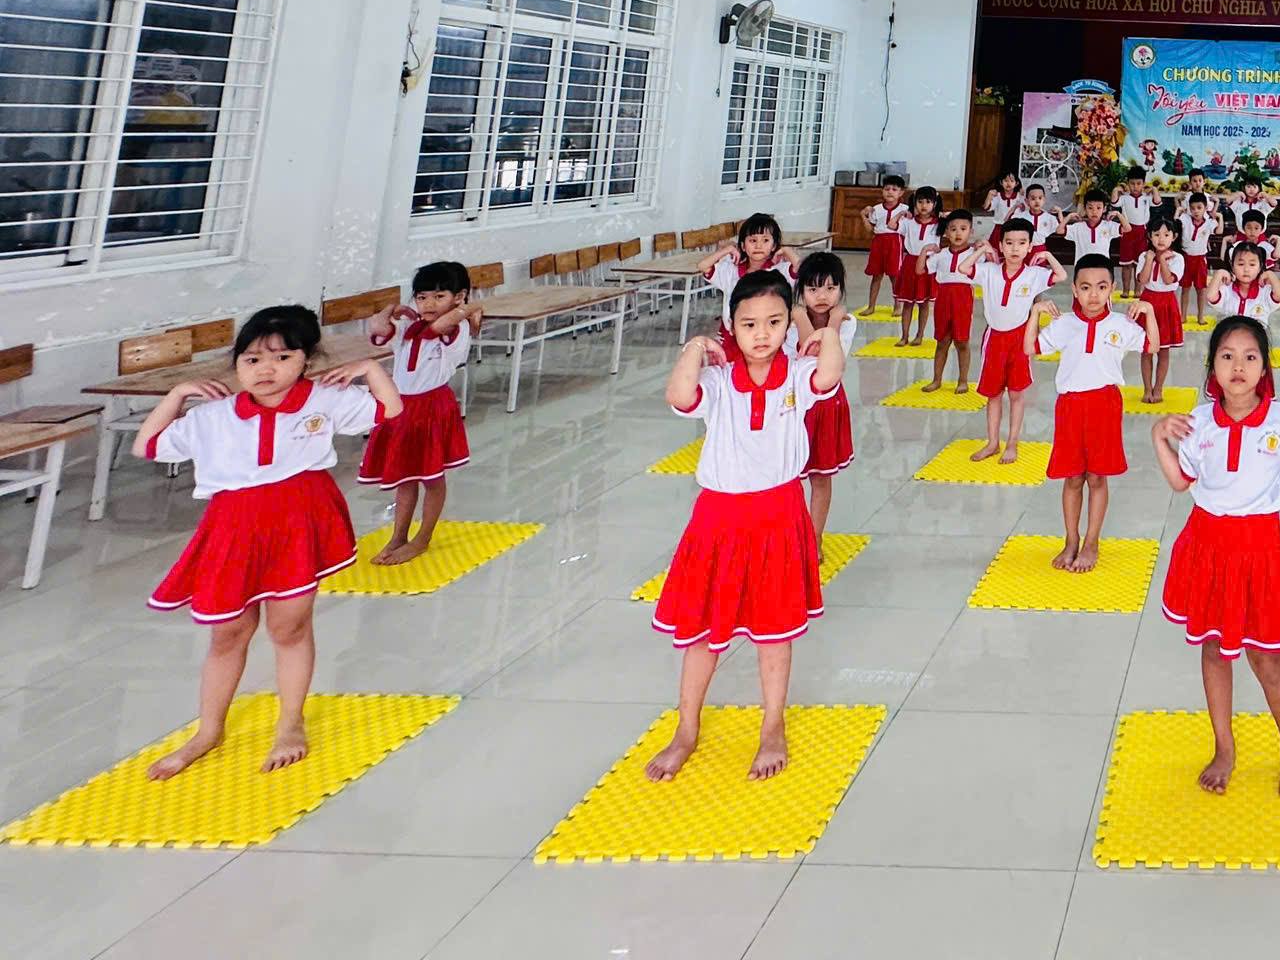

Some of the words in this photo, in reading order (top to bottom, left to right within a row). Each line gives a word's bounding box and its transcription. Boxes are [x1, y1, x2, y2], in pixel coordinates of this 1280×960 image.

[1162, 66, 1232, 83] CHƯƠNG
[1214, 91, 1249, 110] VIỆT
[1203, 125, 1220, 139] HỌC
